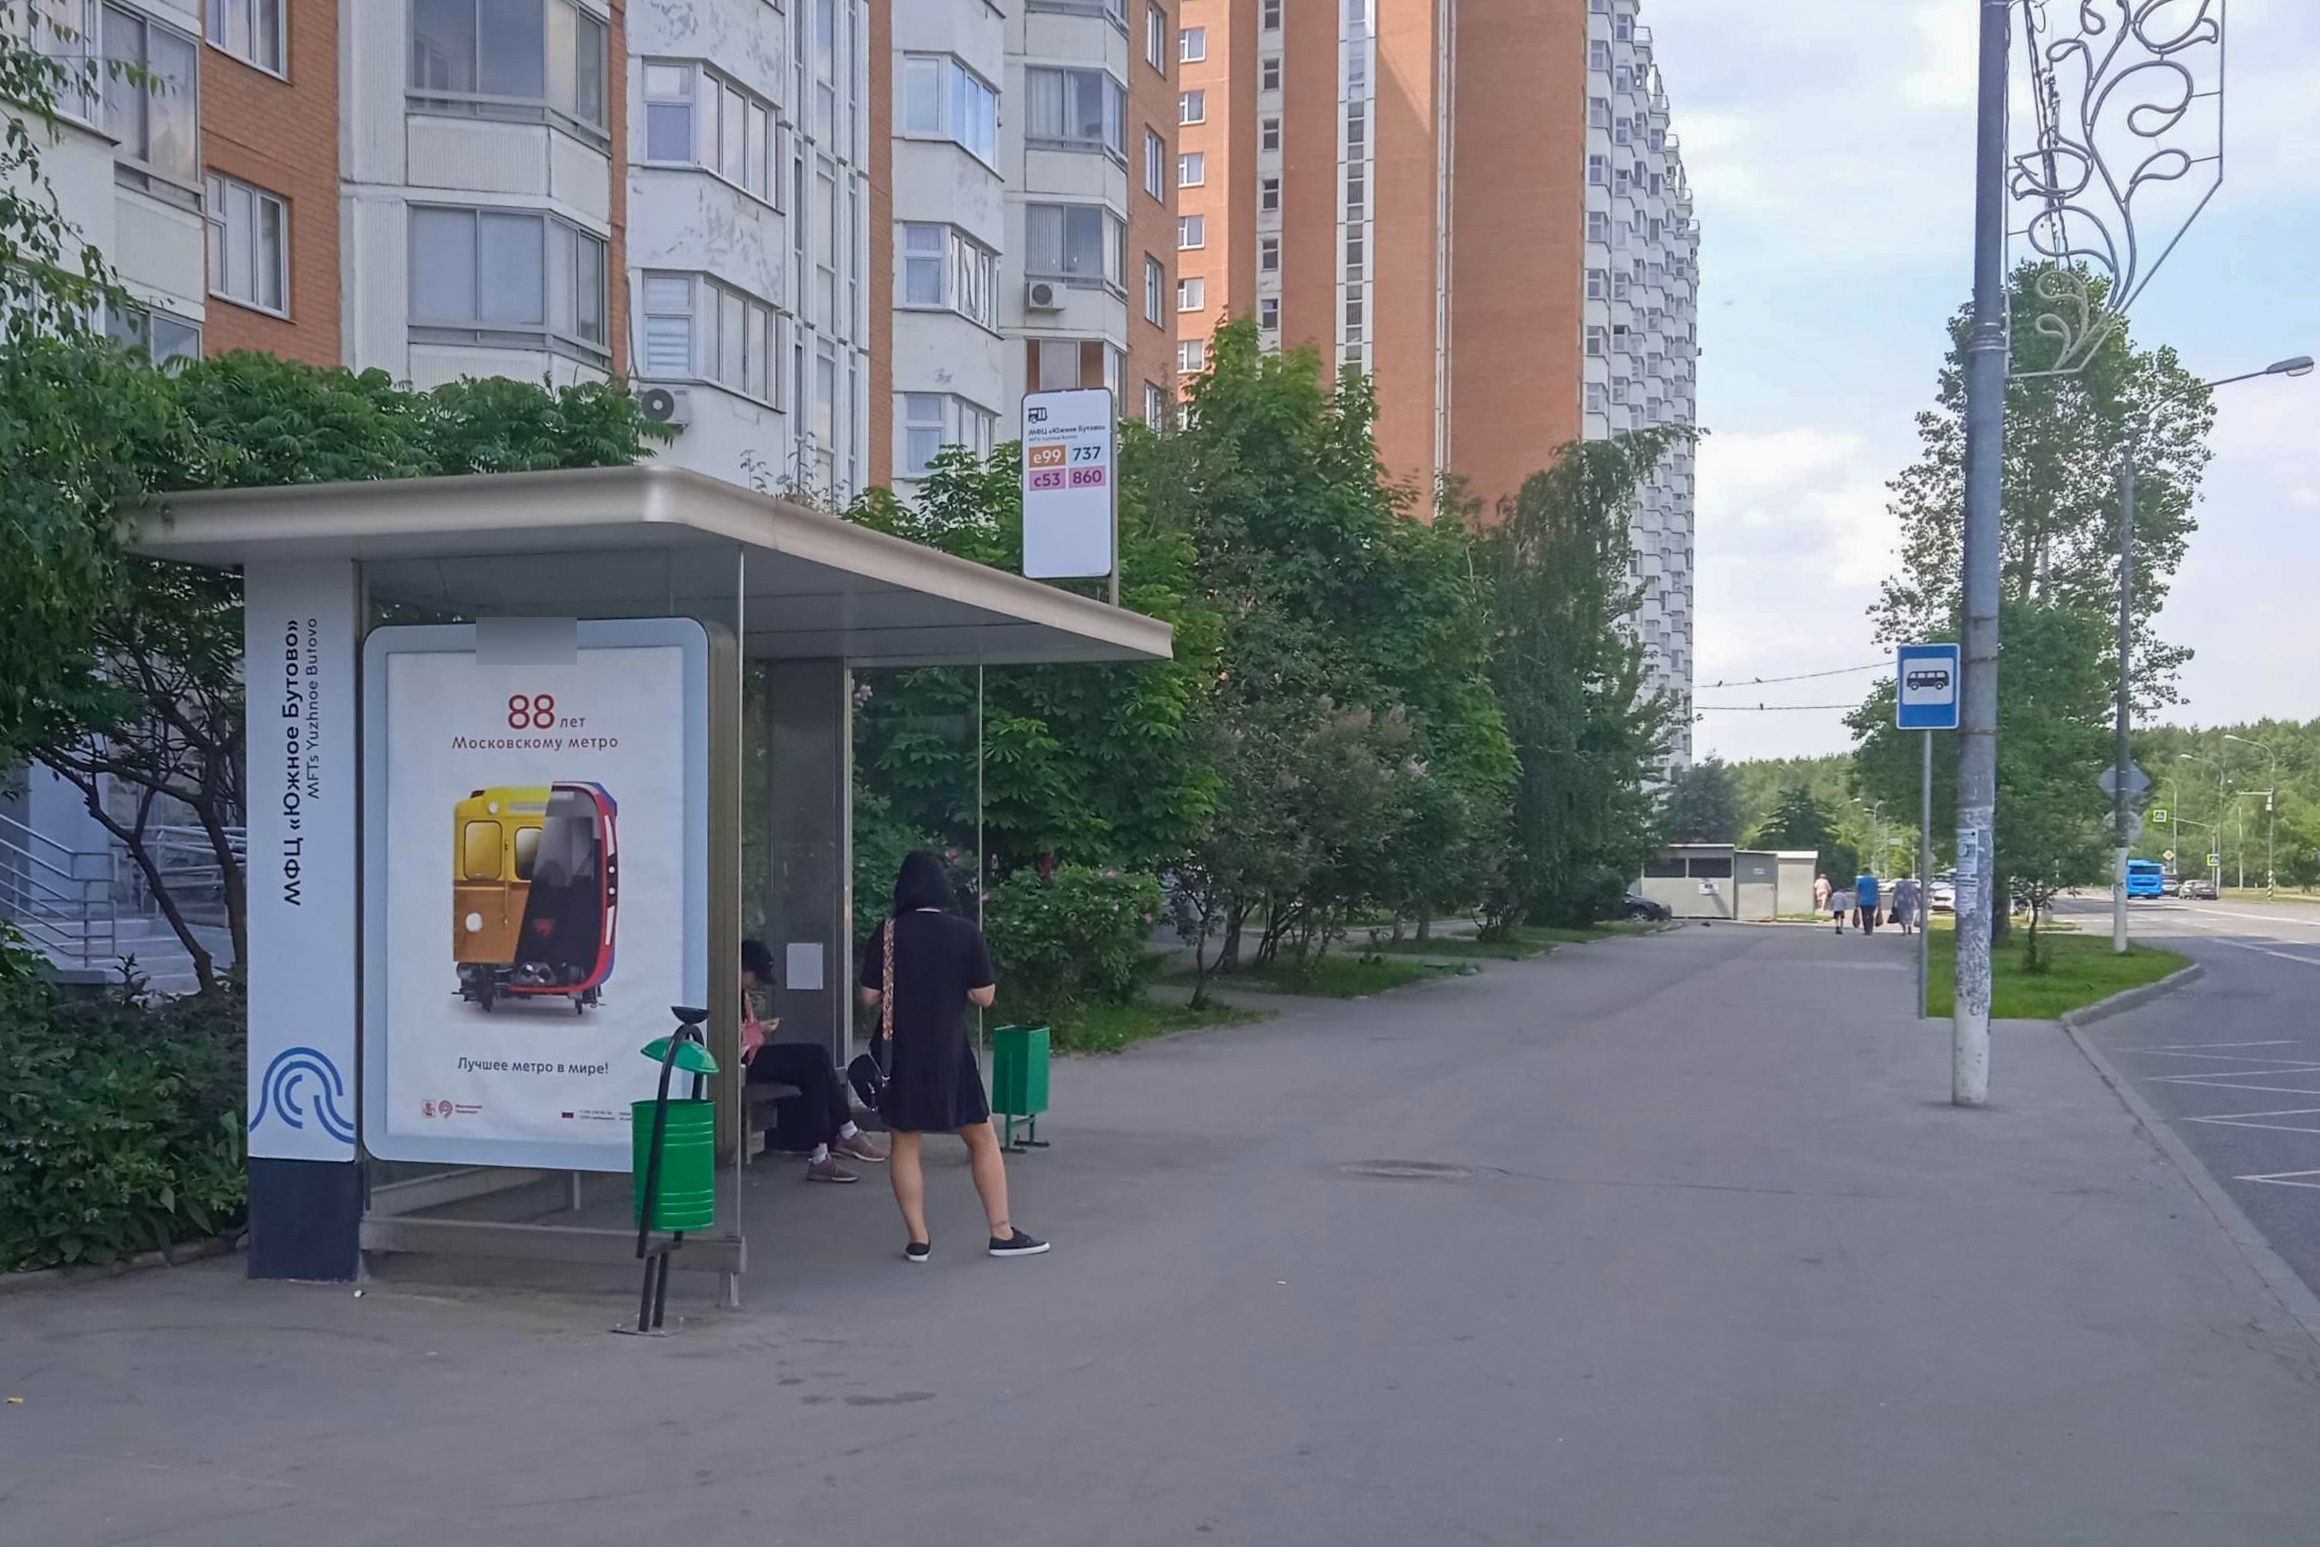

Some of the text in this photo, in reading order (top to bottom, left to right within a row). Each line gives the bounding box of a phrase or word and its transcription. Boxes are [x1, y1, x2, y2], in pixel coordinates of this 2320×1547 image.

[1073, 445, 1101, 461] 737
[1073, 470, 1102, 484] 860
[305, 618, 320, 800] MFTs Yuzhnoe Butovo
[507, 694, 587, 730] 88 лет
[451, 736, 618, 752] Московскому метро
[282, 620, 304, 906] МФЦ «Южное Бутово»
[457, 1057, 609, 1077] Лучшее метро в мире!
